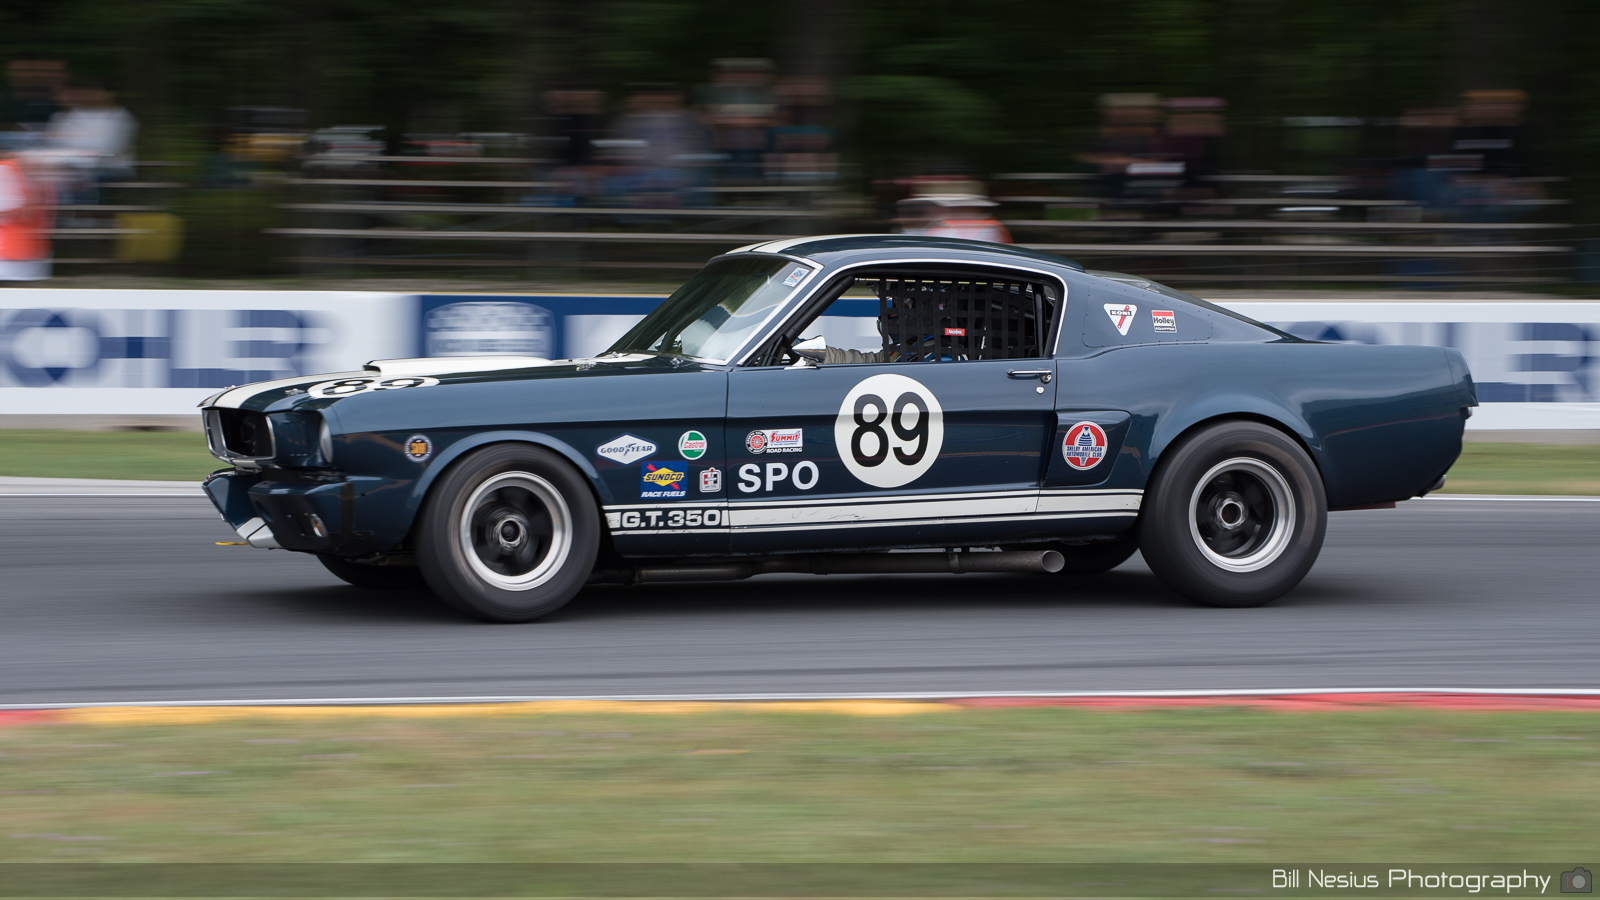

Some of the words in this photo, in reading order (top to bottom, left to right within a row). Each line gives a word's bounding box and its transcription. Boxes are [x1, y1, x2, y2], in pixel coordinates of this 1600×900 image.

[1153, 317, 1175, 326] Holley
[851, 391, 929, 467] 89
[684, 441, 704, 449] Castrol
[646, 473, 682, 481] SUNOCO
[738, 461, 819, 493] SPO
